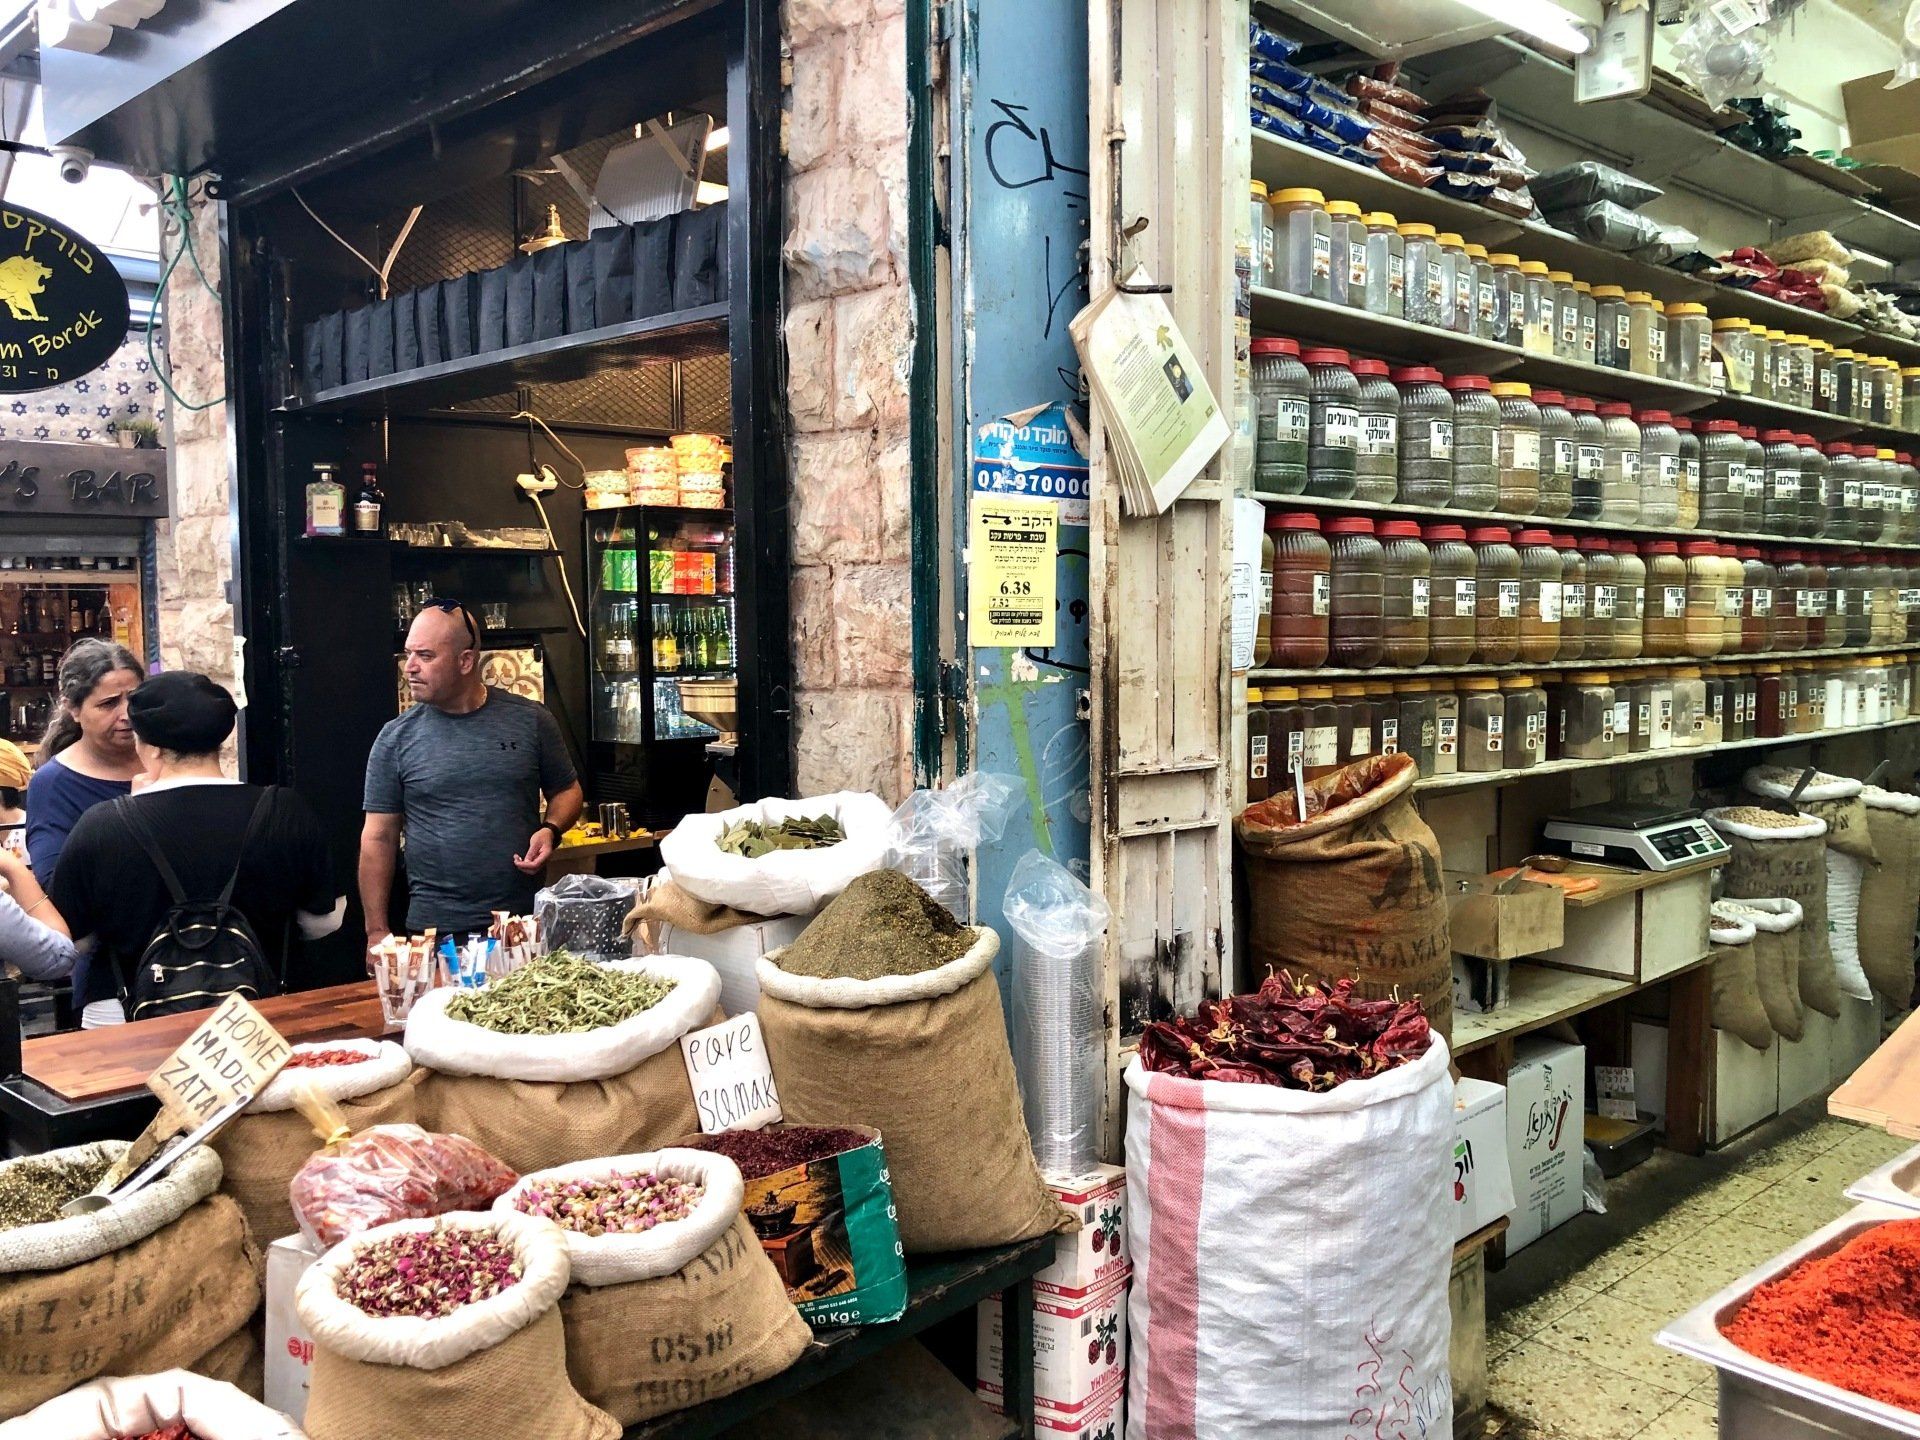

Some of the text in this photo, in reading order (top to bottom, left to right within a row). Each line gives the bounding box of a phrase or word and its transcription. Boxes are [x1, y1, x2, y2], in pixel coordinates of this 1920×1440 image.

[28, 310, 103, 355] Borek
[1328, 412, 1346, 425] עלים
[1368, 418, 1388, 428] אורגנו
[1291, 429, 1298, 439] 12
[1339, 436, 1346, 445] 14
[1366, 428, 1390, 441] איטלקי
[67, 470, 160, 503] BAR
[1003, 532, 1022, 541] פרשת
[1029, 533, 1045, 541] שבת
[1000, 581, 1031, 595] 6.38
[215, 1001, 288, 1071] HOME
[192, 1029, 256, 1095] MADE
[159, 1056, 229, 1121] ZATA
[1094, 1256, 1124, 1279] SHUKHA
[810, 1314, 826, 1325] 10
[830, 1311, 849, 1324] Kg
[1090, 1364, 1120, 1390] SHUKHA
